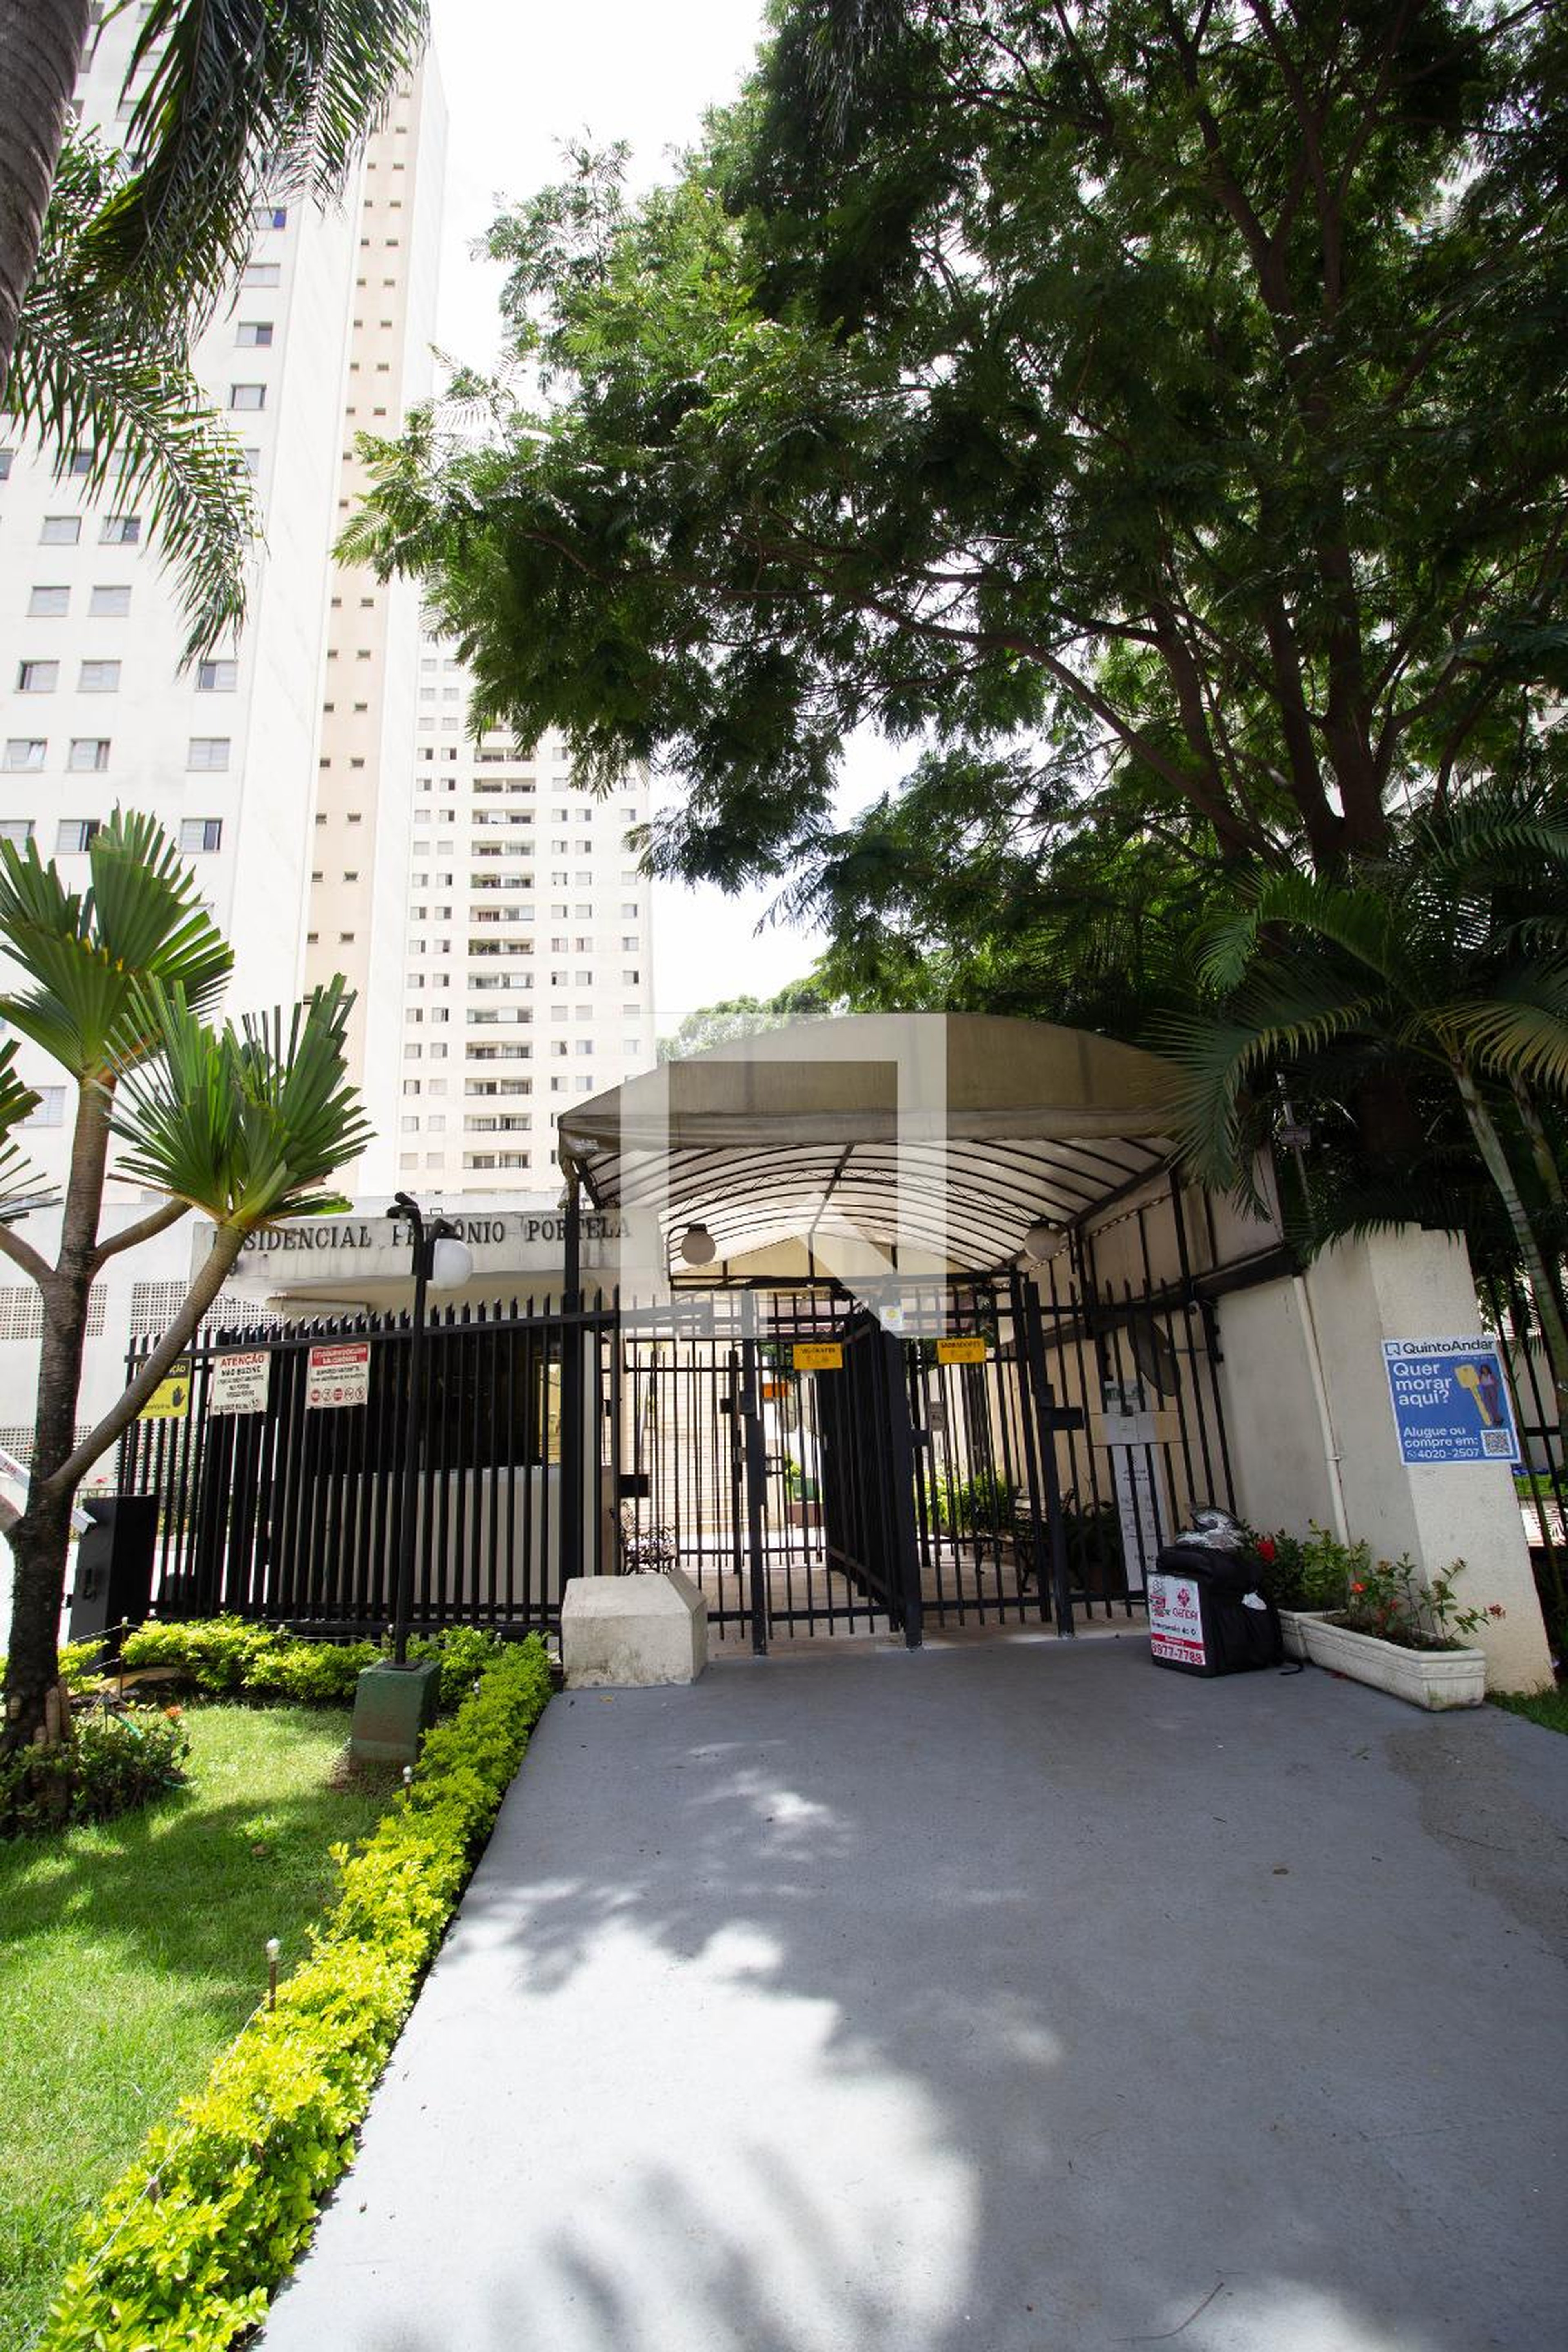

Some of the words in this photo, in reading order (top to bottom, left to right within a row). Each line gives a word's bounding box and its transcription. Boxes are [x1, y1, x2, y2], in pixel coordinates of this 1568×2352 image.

[213, 1226, 371, 1250] SIDENCIAL
[1403, 1339, 1494, 1355] QuintoAndar
[221, 1353, 265, 1367] ATENÇÃO
[1393, 1362, 1440, 1376] Quer
[1396, 1378, 1452, 1391] morar
[1399, 1389, 1449, 1408] aqui?
[1403, 1426, 1448, 1439] Alugue
[1449, 1427, 1466, 1436] ou
[1405, 1438, 1452, 1449] compre
[1455, 1436, 1479, 1446] em:
[1418, 1448, 1480, 1459] 4020-2507
